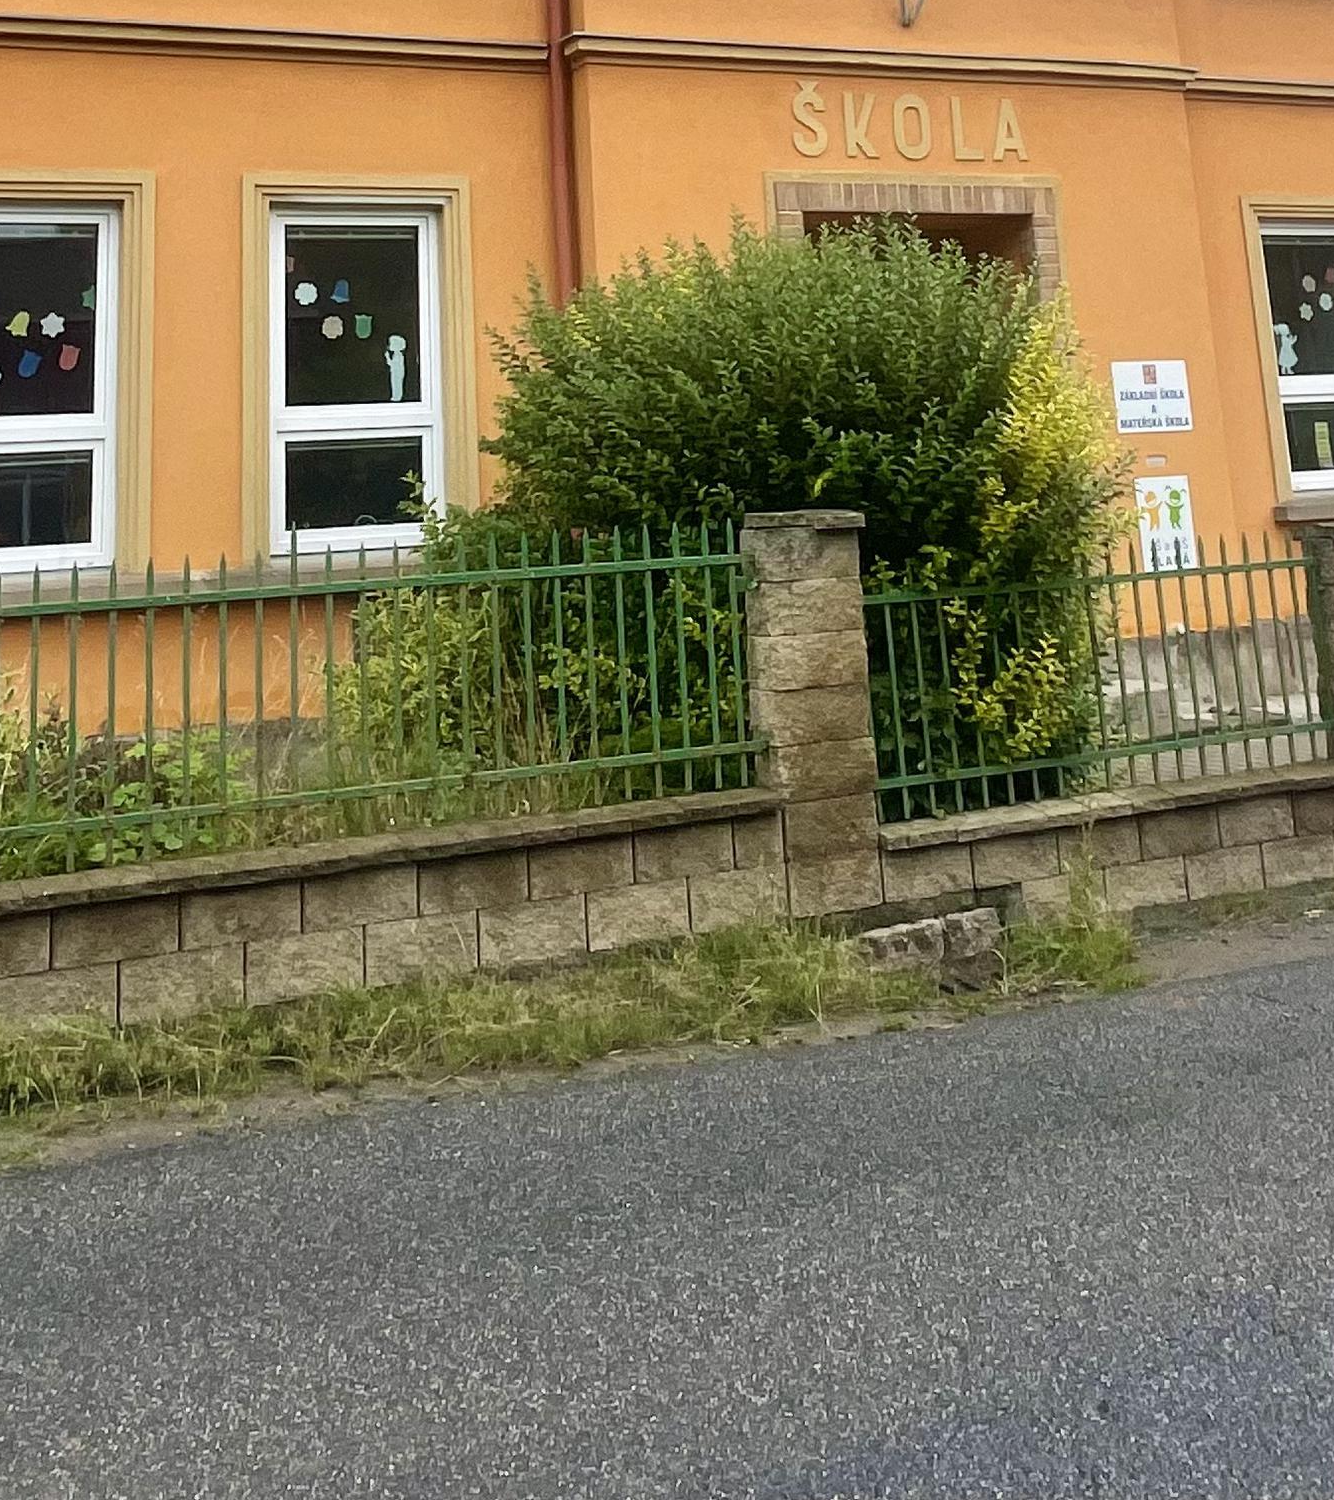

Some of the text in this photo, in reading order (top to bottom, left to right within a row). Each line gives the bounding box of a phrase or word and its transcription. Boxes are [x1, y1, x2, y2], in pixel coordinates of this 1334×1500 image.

[792, 81, 1028, 162] ŠKOLA
[1120, 387, 1184, 401] ZÁKLADNÍ ŠKOLA
[1151, 404, 1157, 413] A
[1165, 415, 1189, 427] ŠKOLA
